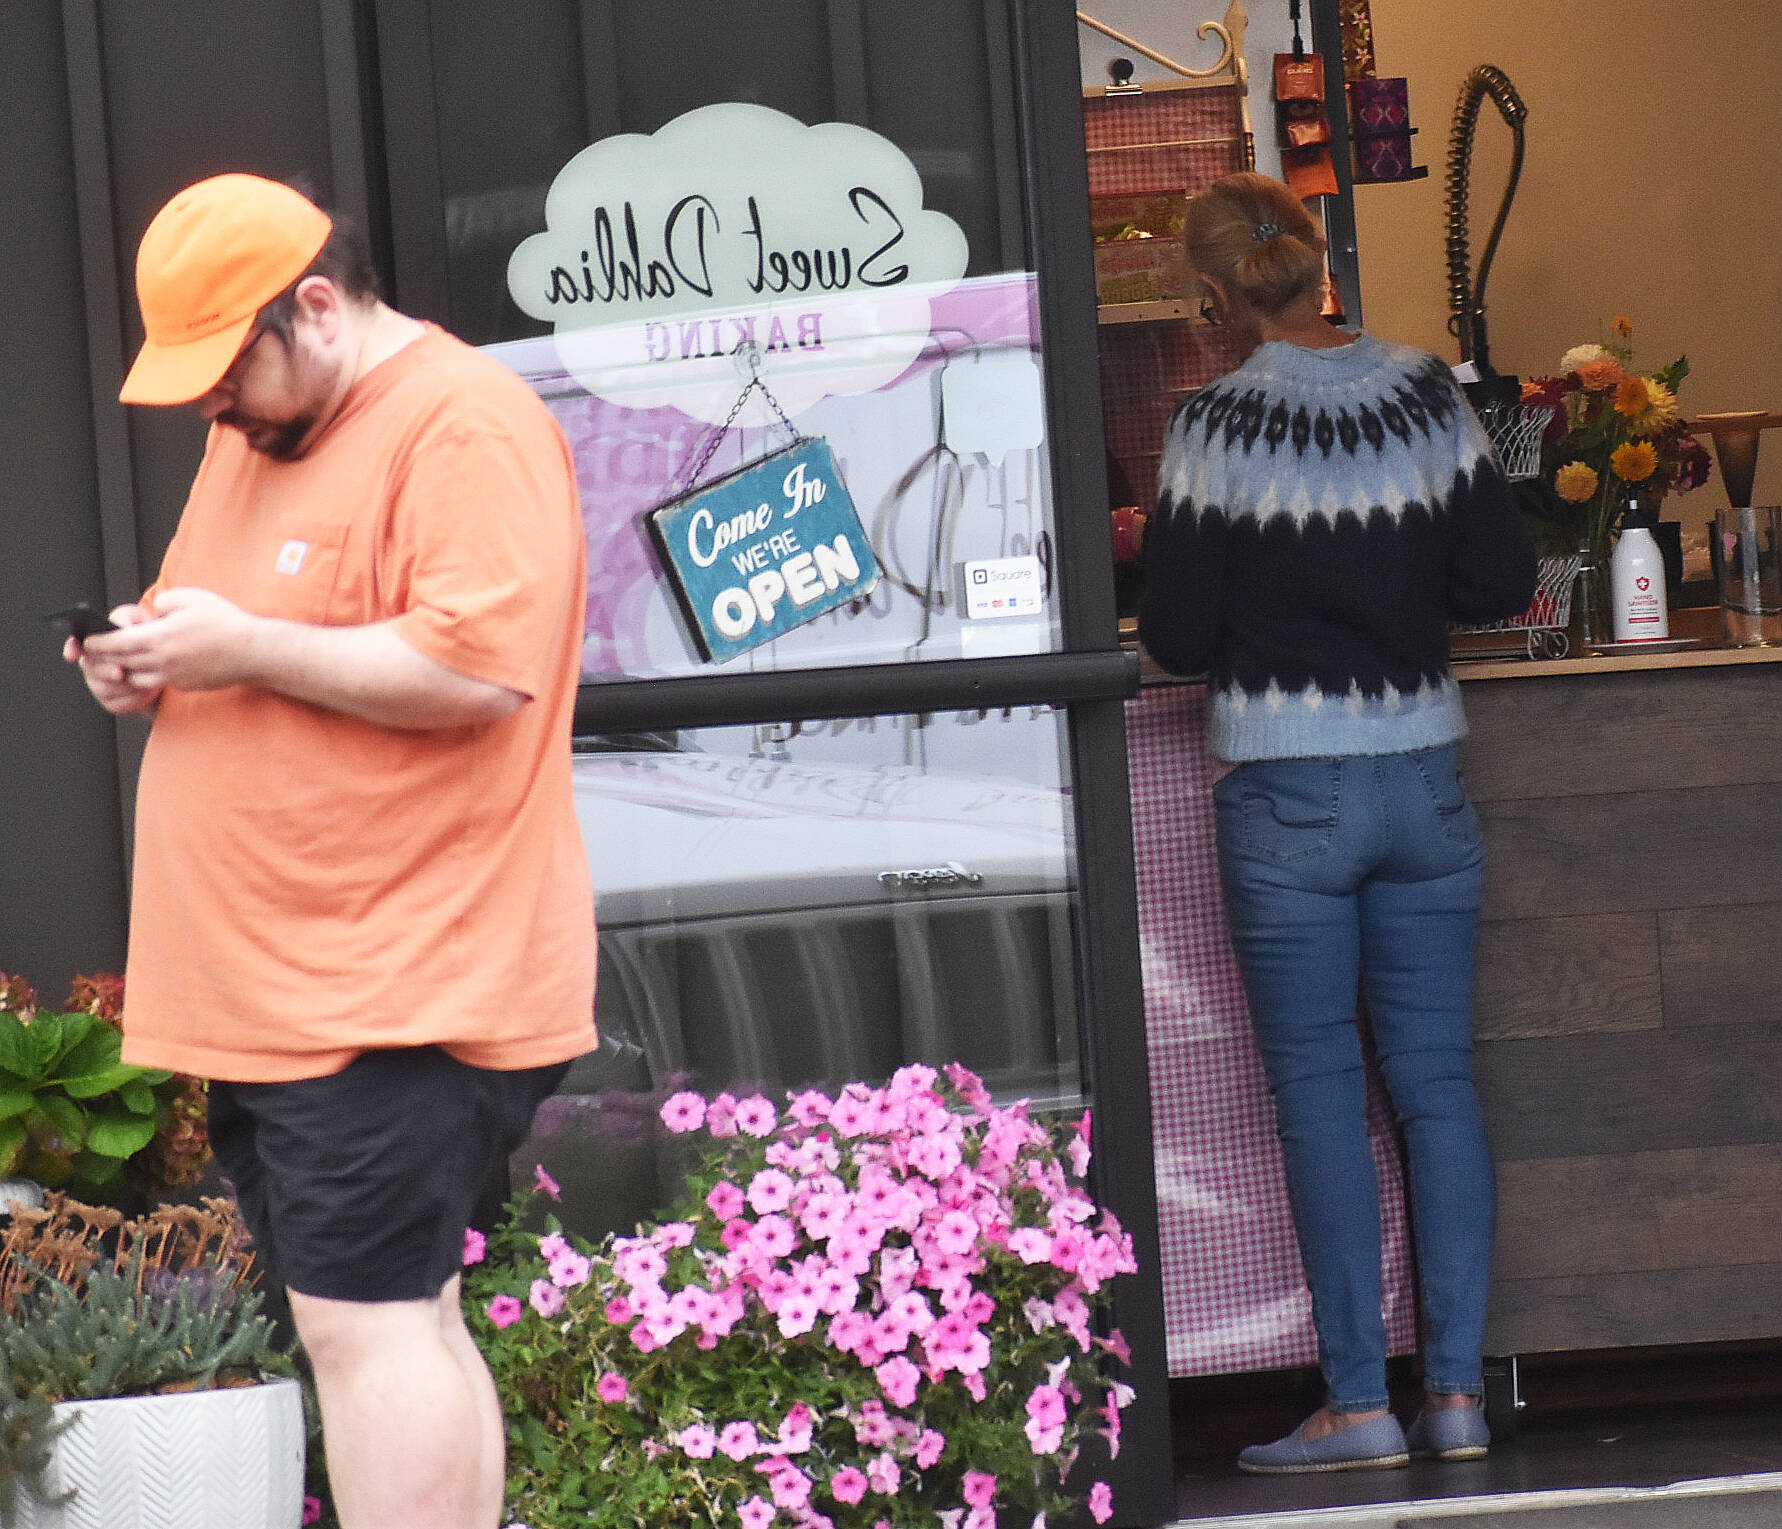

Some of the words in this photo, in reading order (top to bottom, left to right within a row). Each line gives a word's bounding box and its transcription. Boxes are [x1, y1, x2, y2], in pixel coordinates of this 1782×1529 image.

[688, 502, 774, 568] Come
[782, 462, 827, 519] In
[731, 528, 801, 576] WE'RE
[712, 533, 861, 641] OPEN
[990, 570, 1032, 582] Square
